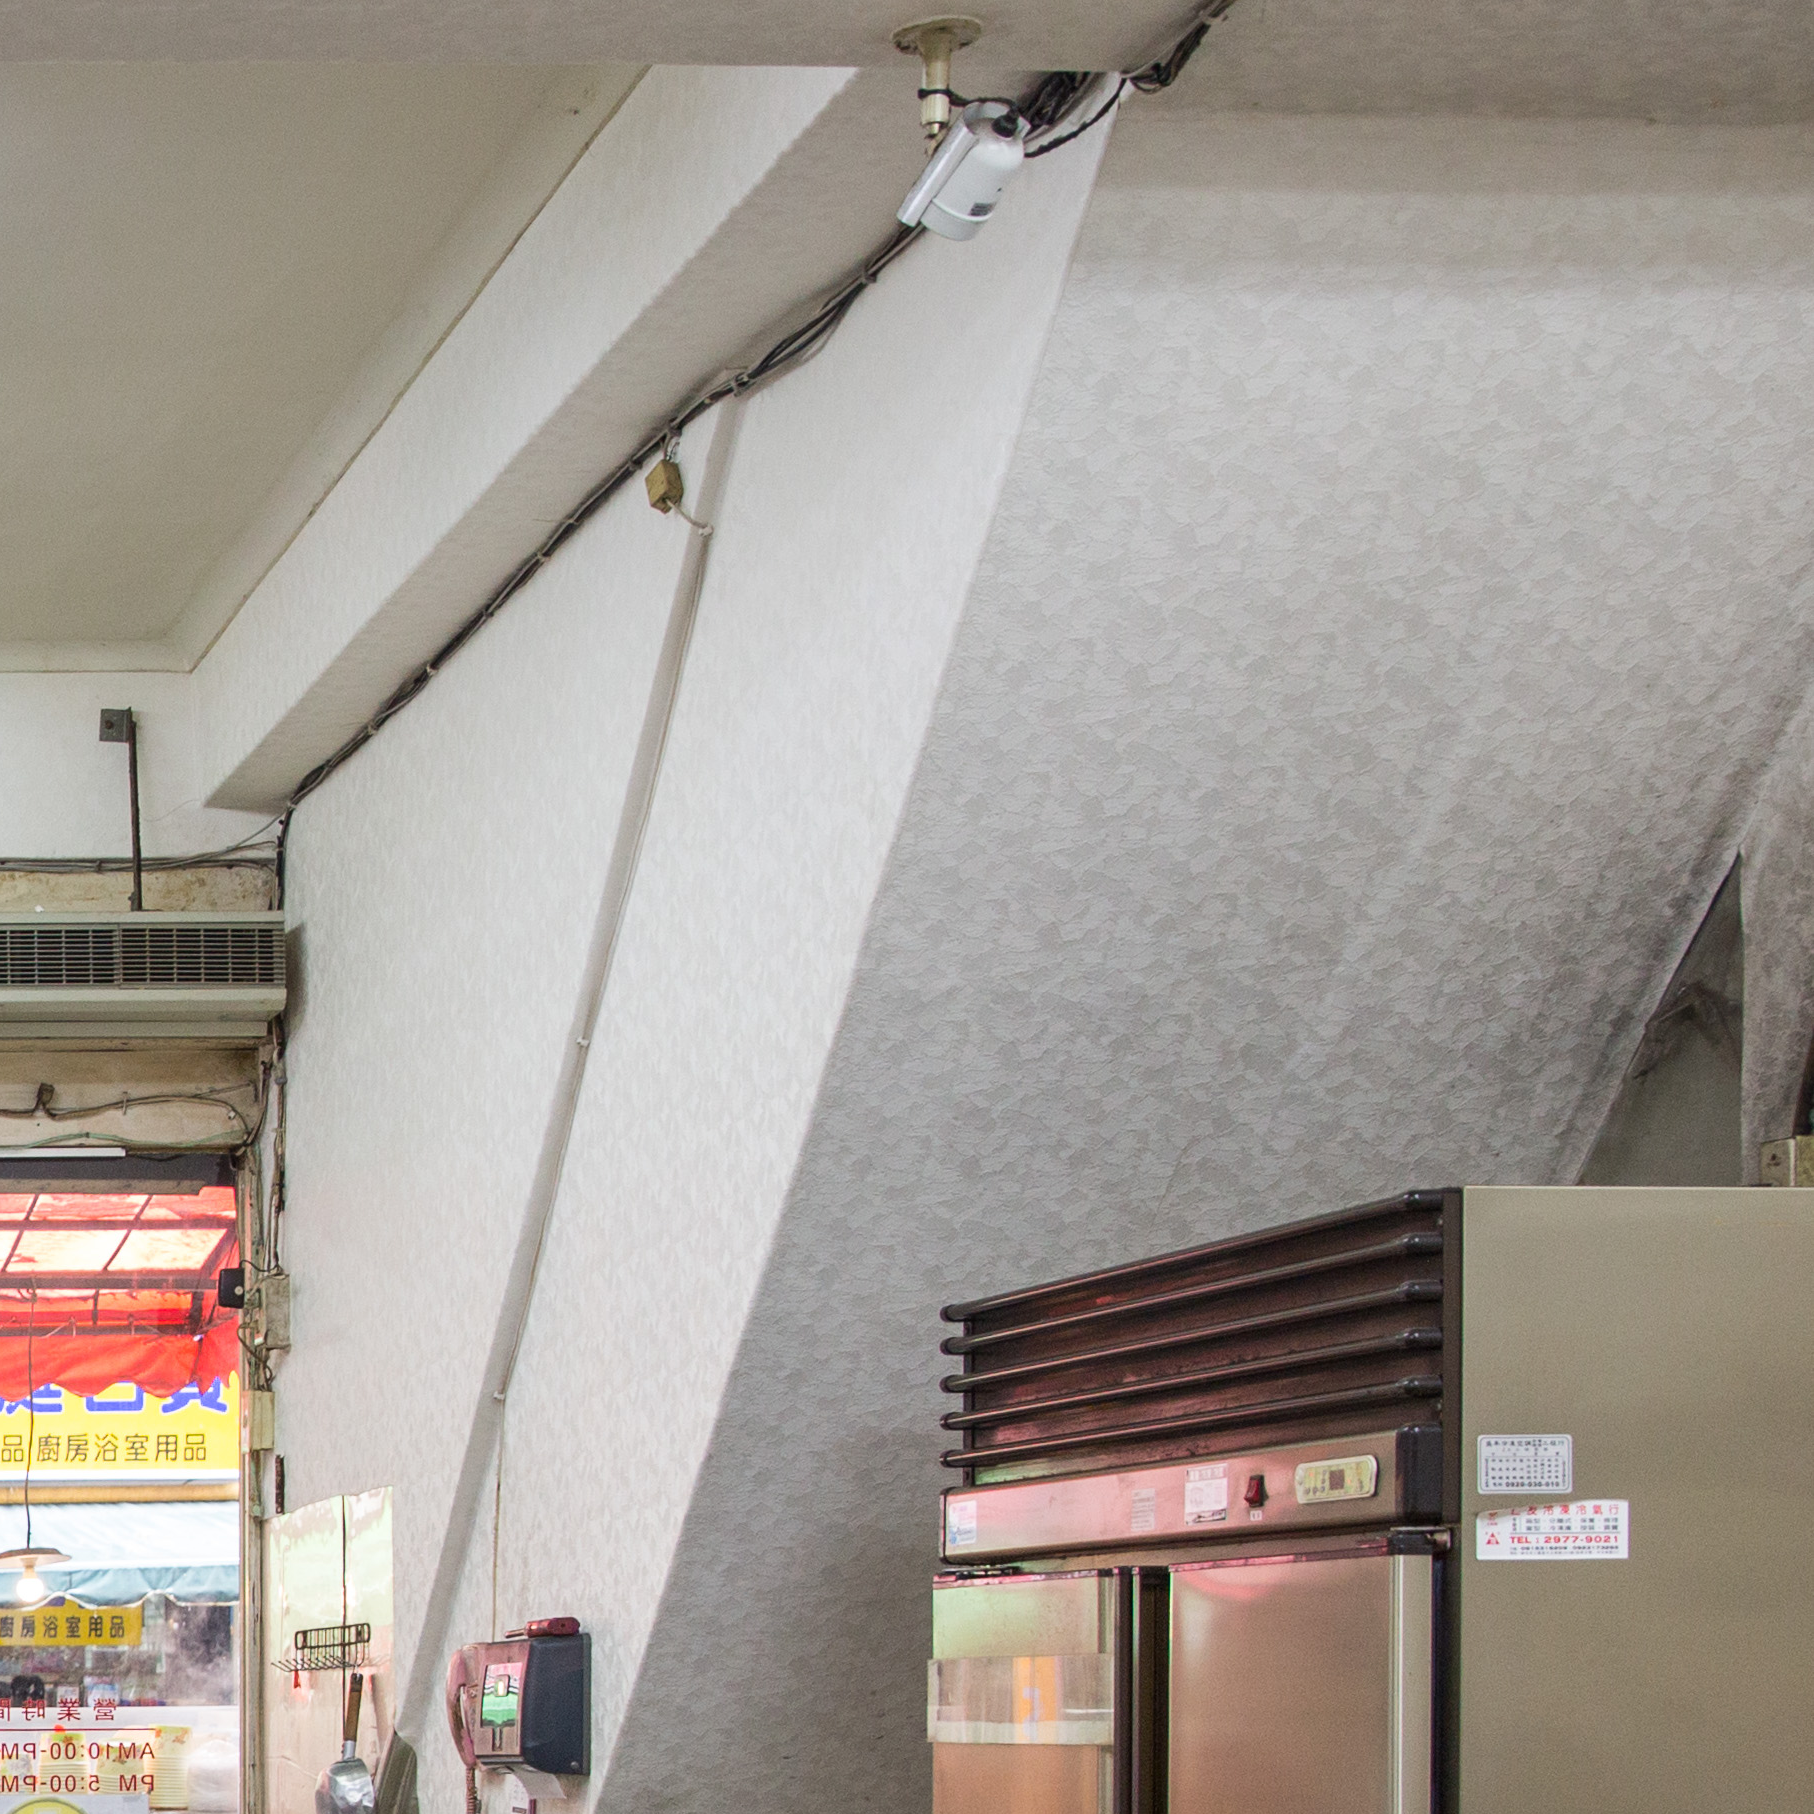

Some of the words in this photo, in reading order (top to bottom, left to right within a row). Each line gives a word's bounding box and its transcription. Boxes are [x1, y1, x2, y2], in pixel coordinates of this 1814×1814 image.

[37, 1433, 207, 1463] 廚房浴室用品
[1544, 1536, 1619, 1544] 2977-9021
